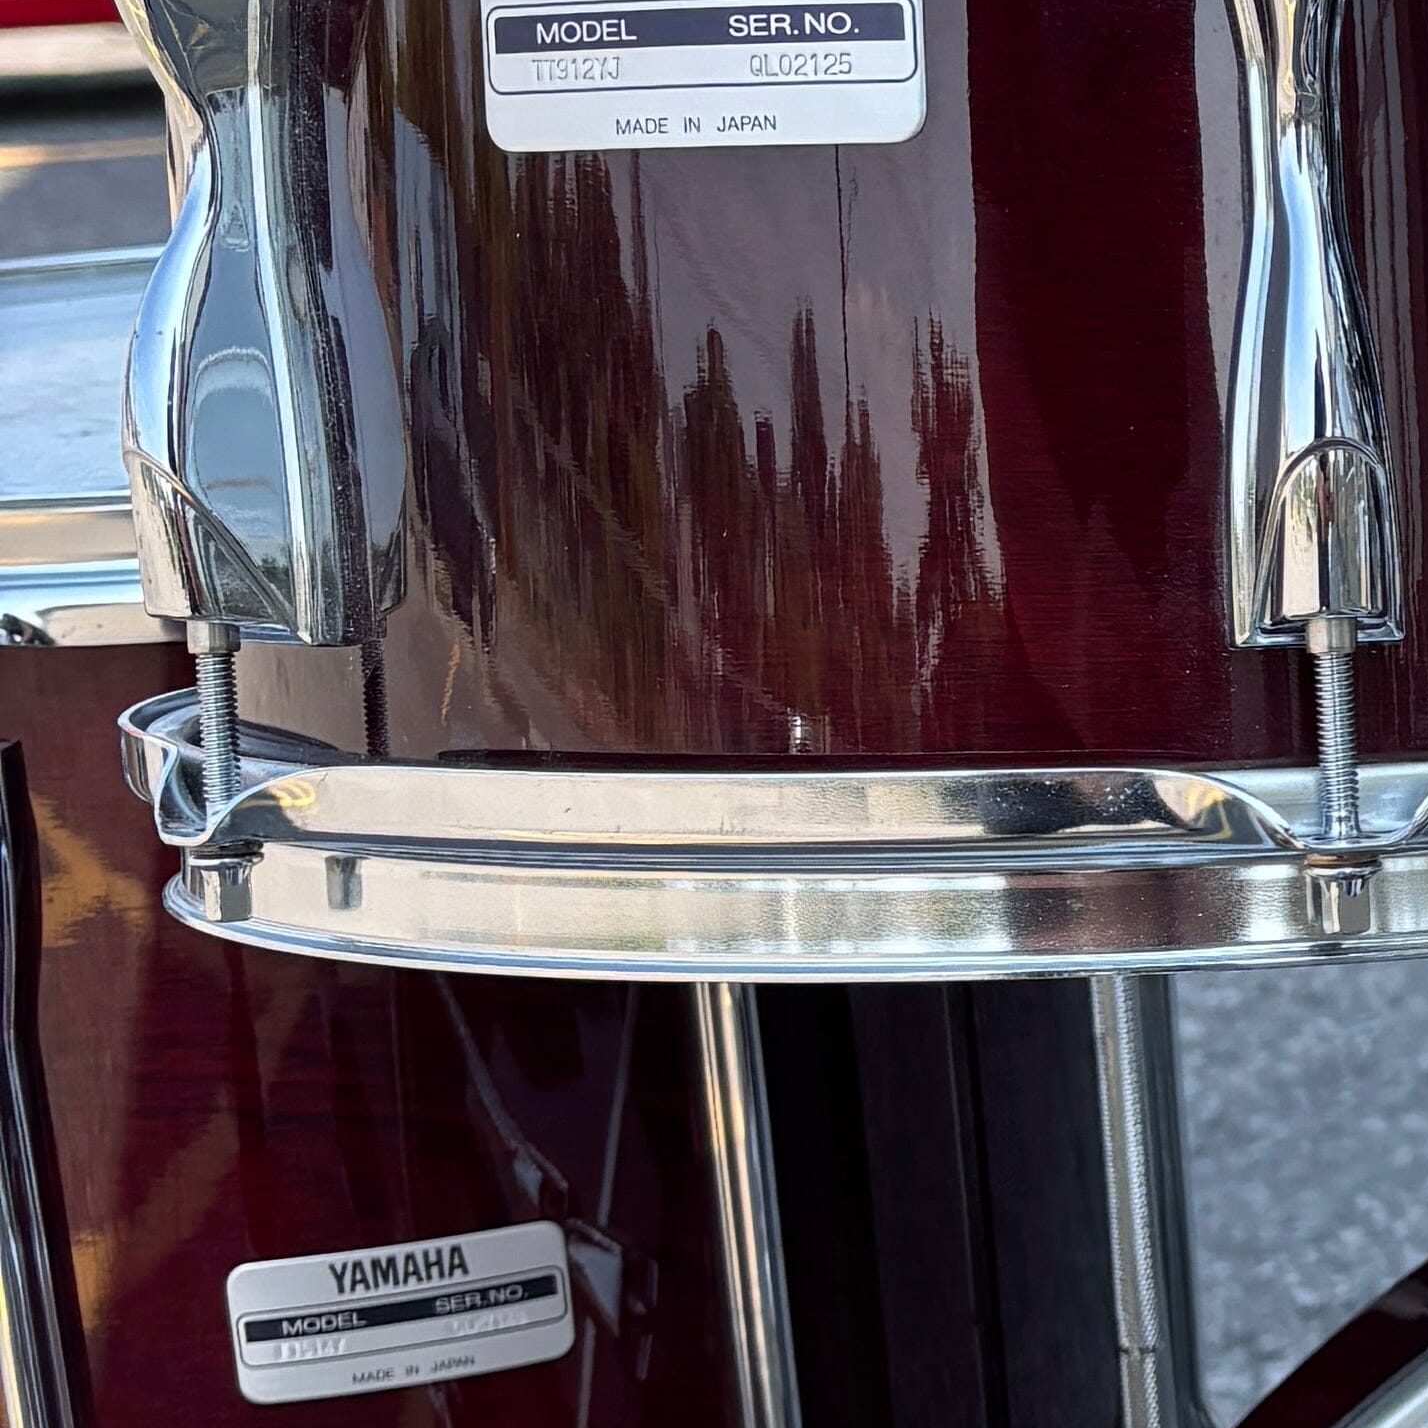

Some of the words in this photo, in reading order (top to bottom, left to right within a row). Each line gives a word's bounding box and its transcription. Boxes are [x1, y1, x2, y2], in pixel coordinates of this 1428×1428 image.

[536, 18, 638, 45] MODEL
[532, 56, 620, 81] TT912YJ
[749, 51, 852, 77] QL02125
[615, 117, 669, 135] MADE
[683, 116, 701, 134] IN
[717, 114, 778, 133] JAPAN
[328, 1243, 470, 1295] YAMAHA
[281, 1311, 368, 1337] MODEL
[351, 1366, 395, 1384] MADE
[430, 1356, 476, 1374] JAPAN
